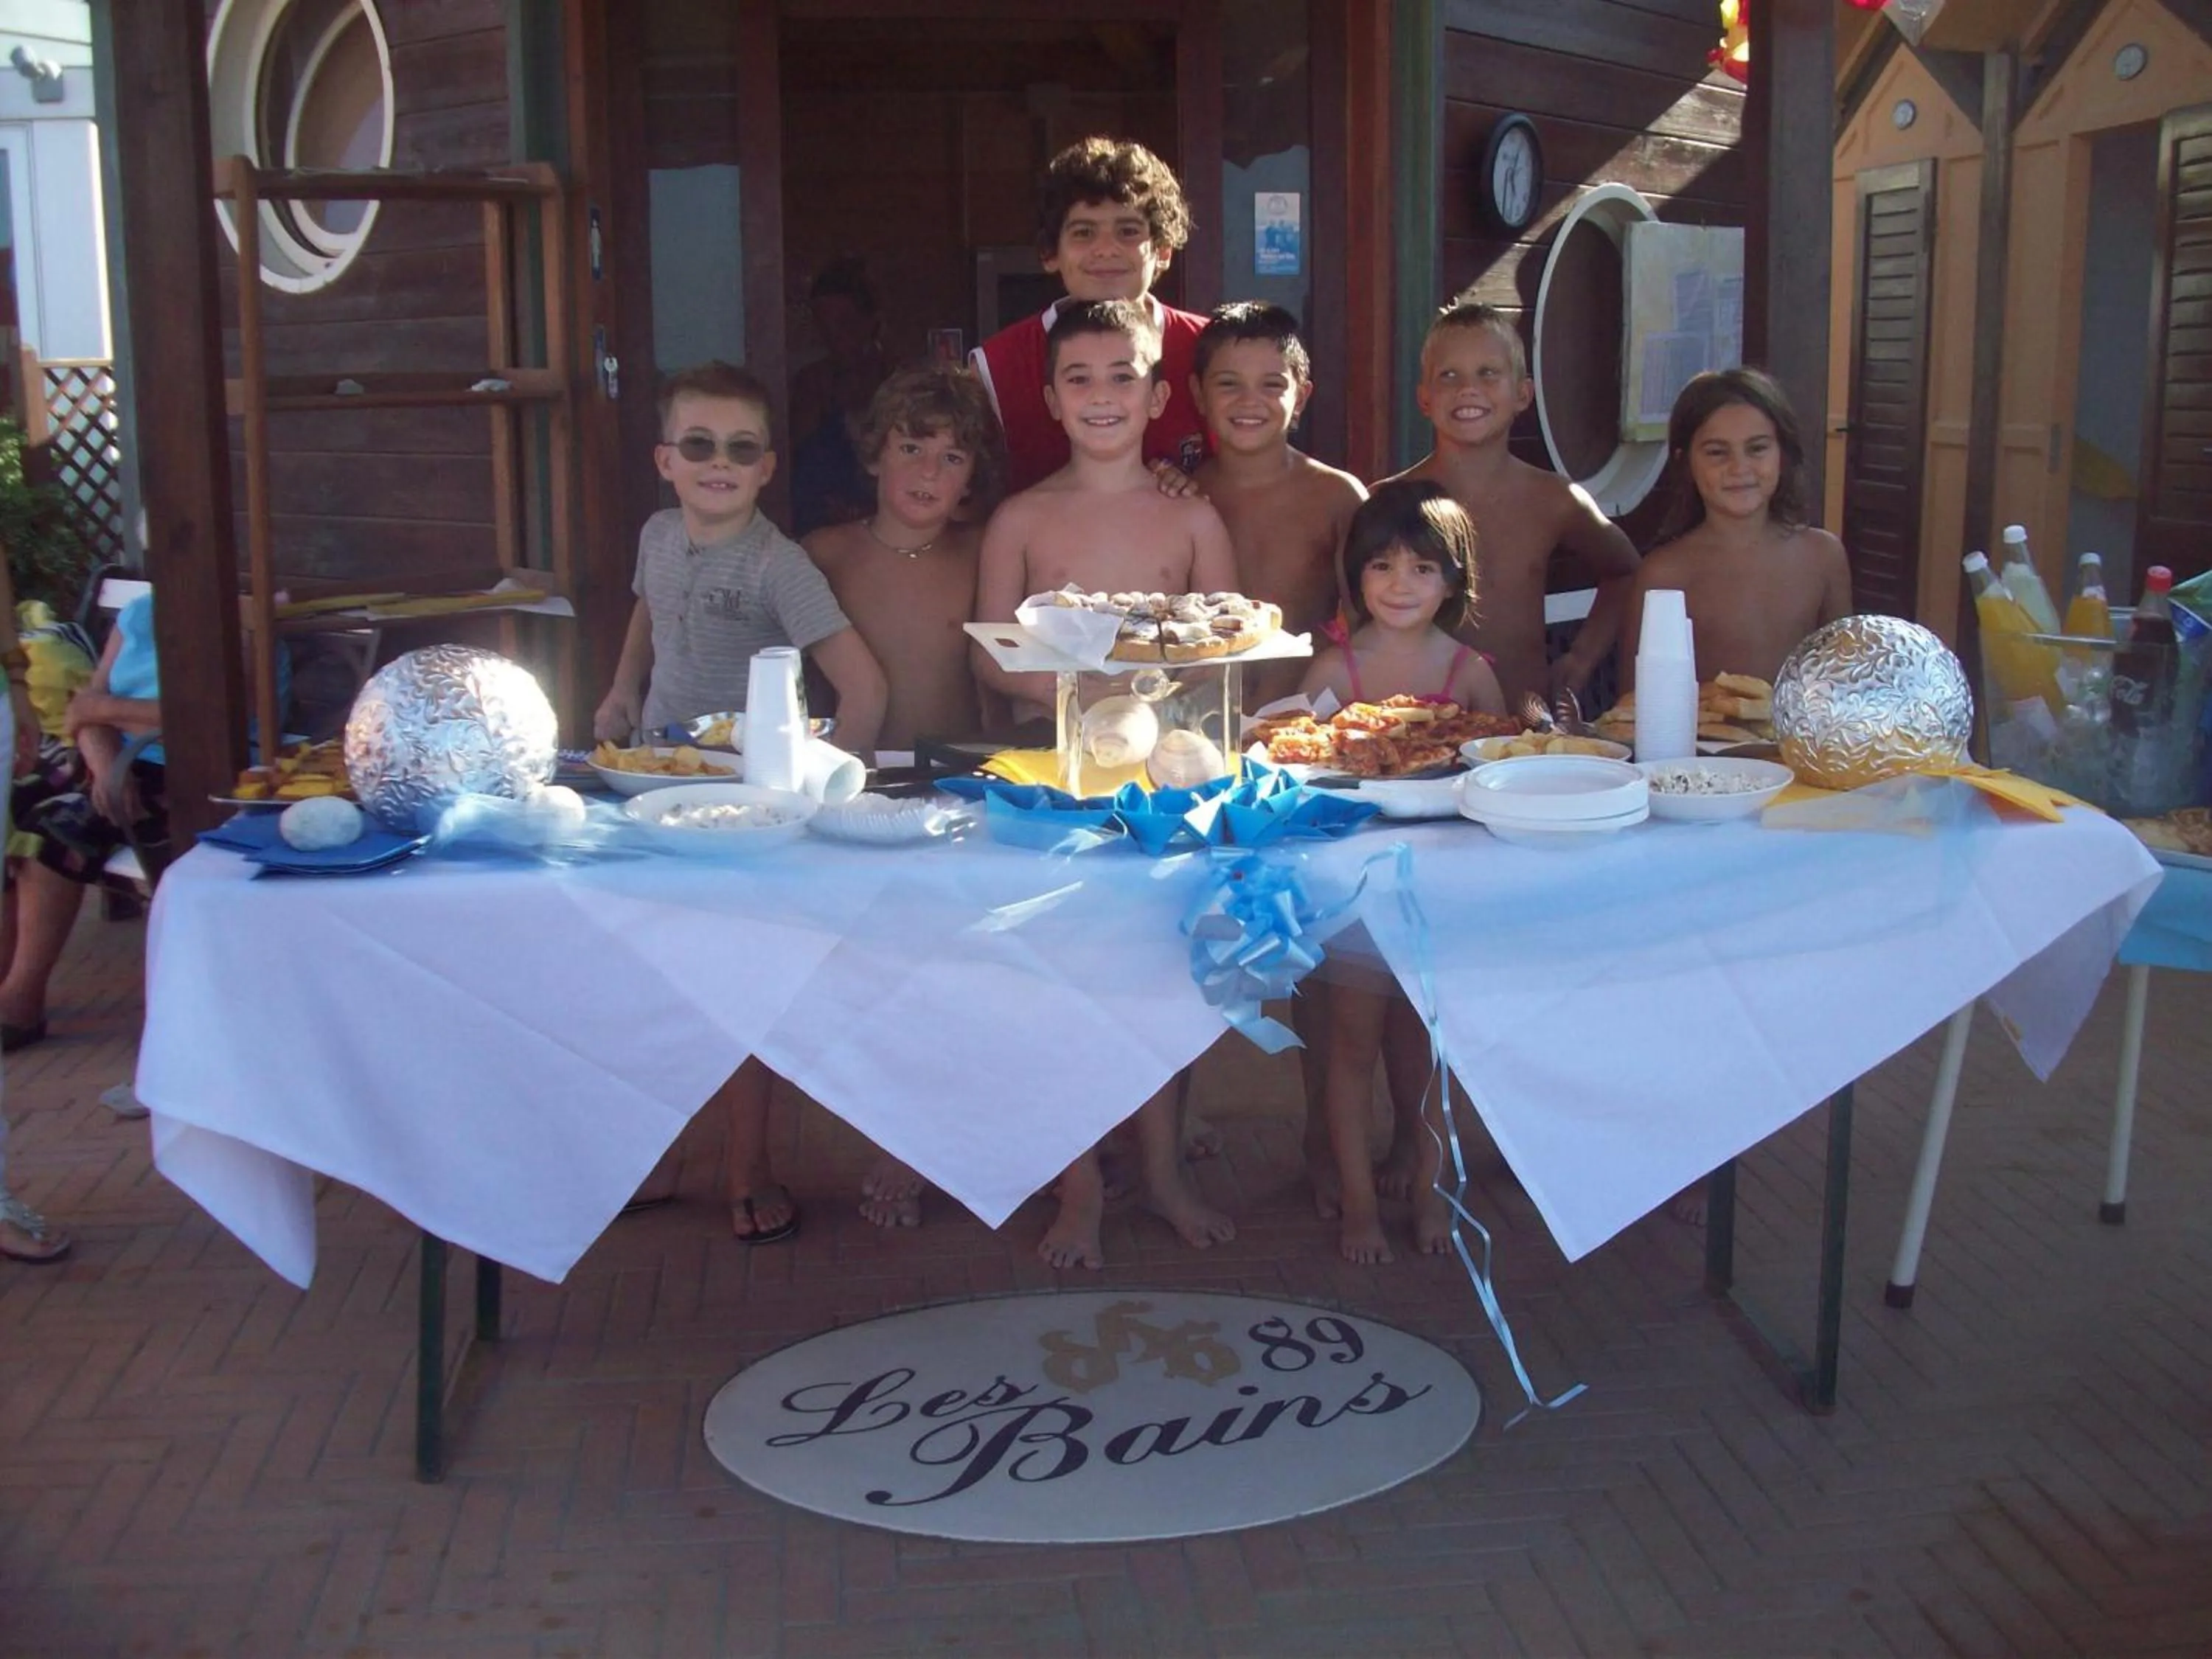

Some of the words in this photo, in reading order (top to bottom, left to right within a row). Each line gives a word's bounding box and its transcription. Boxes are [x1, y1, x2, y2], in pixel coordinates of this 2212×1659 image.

[1248, 1316, 1364, 1372] 89
[765, 1368, 1039, 1447] Les
[864, 1371, 1433, 1507] Bains
